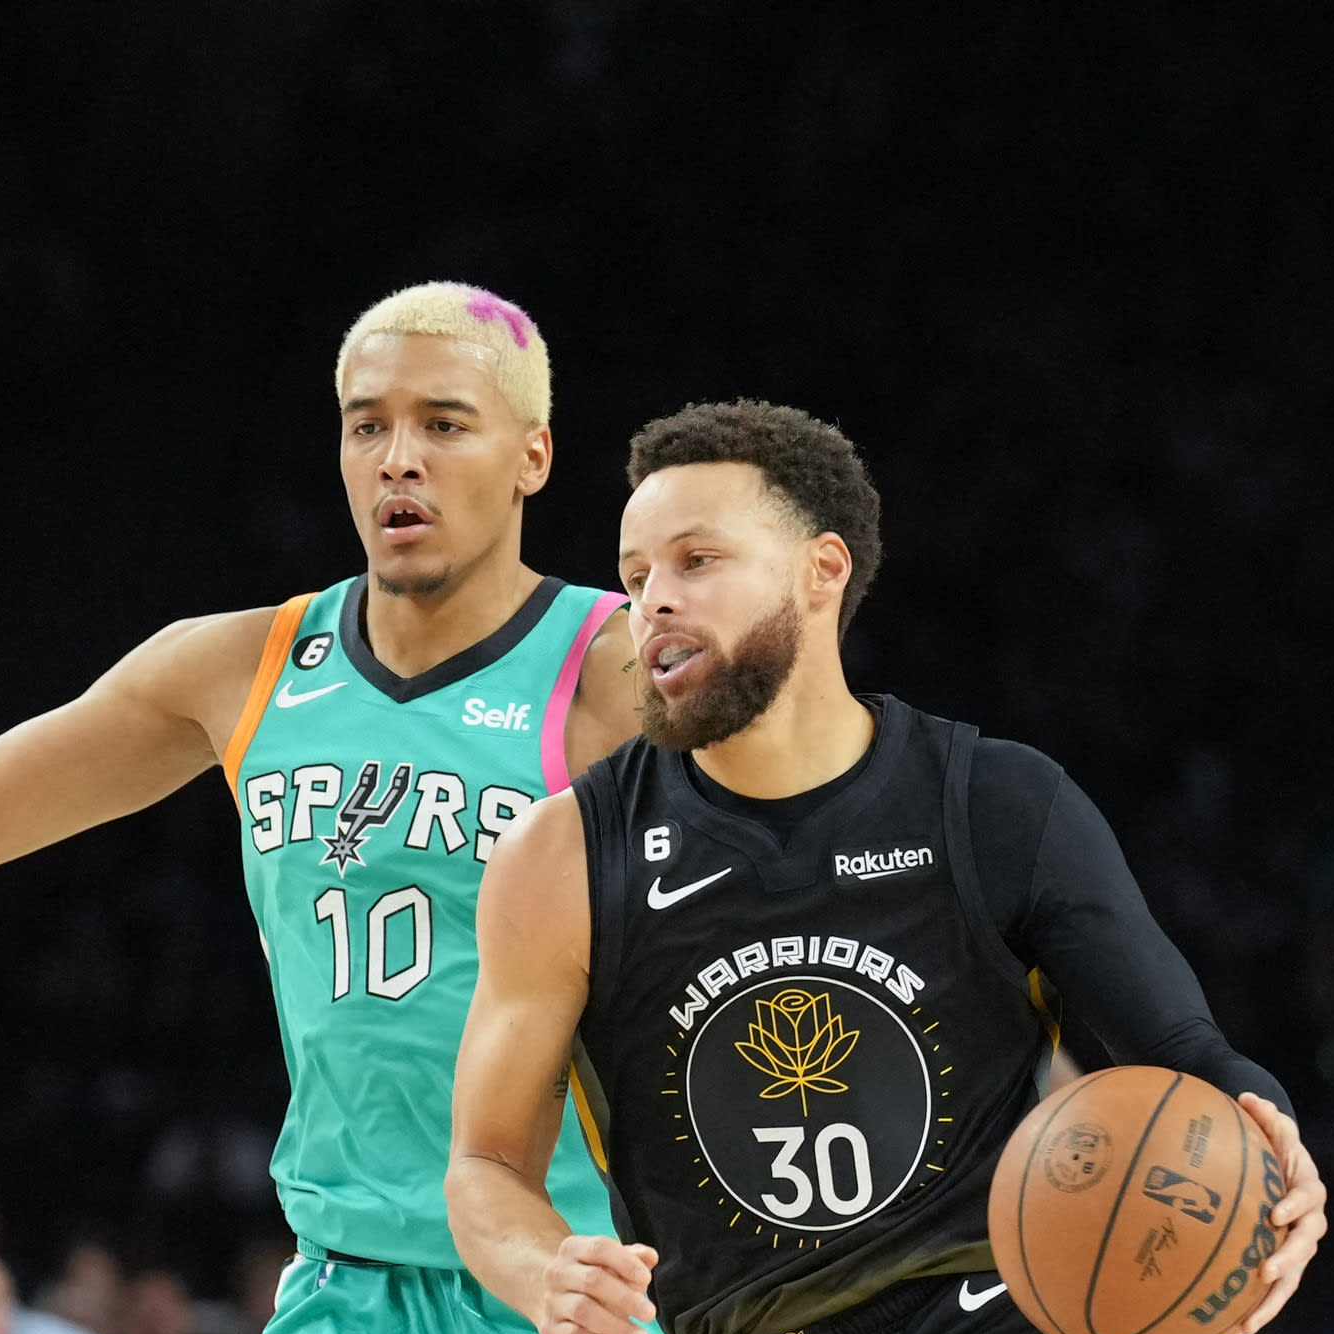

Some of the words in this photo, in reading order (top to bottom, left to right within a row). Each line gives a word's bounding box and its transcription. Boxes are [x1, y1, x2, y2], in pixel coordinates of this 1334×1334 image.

[299, 636, 330, 665] 6
[462, 698, 531, 731] Self.
[245, 760, 535, 875] SPURS
[644, 826, 671, 862] 6
[834, 846, 933, 879] Rakuten
[315, 884, 433, 1002] 10
[669, 936, 926, 1031] WARRIORS
[752, 1122, 873, 1219] 30
